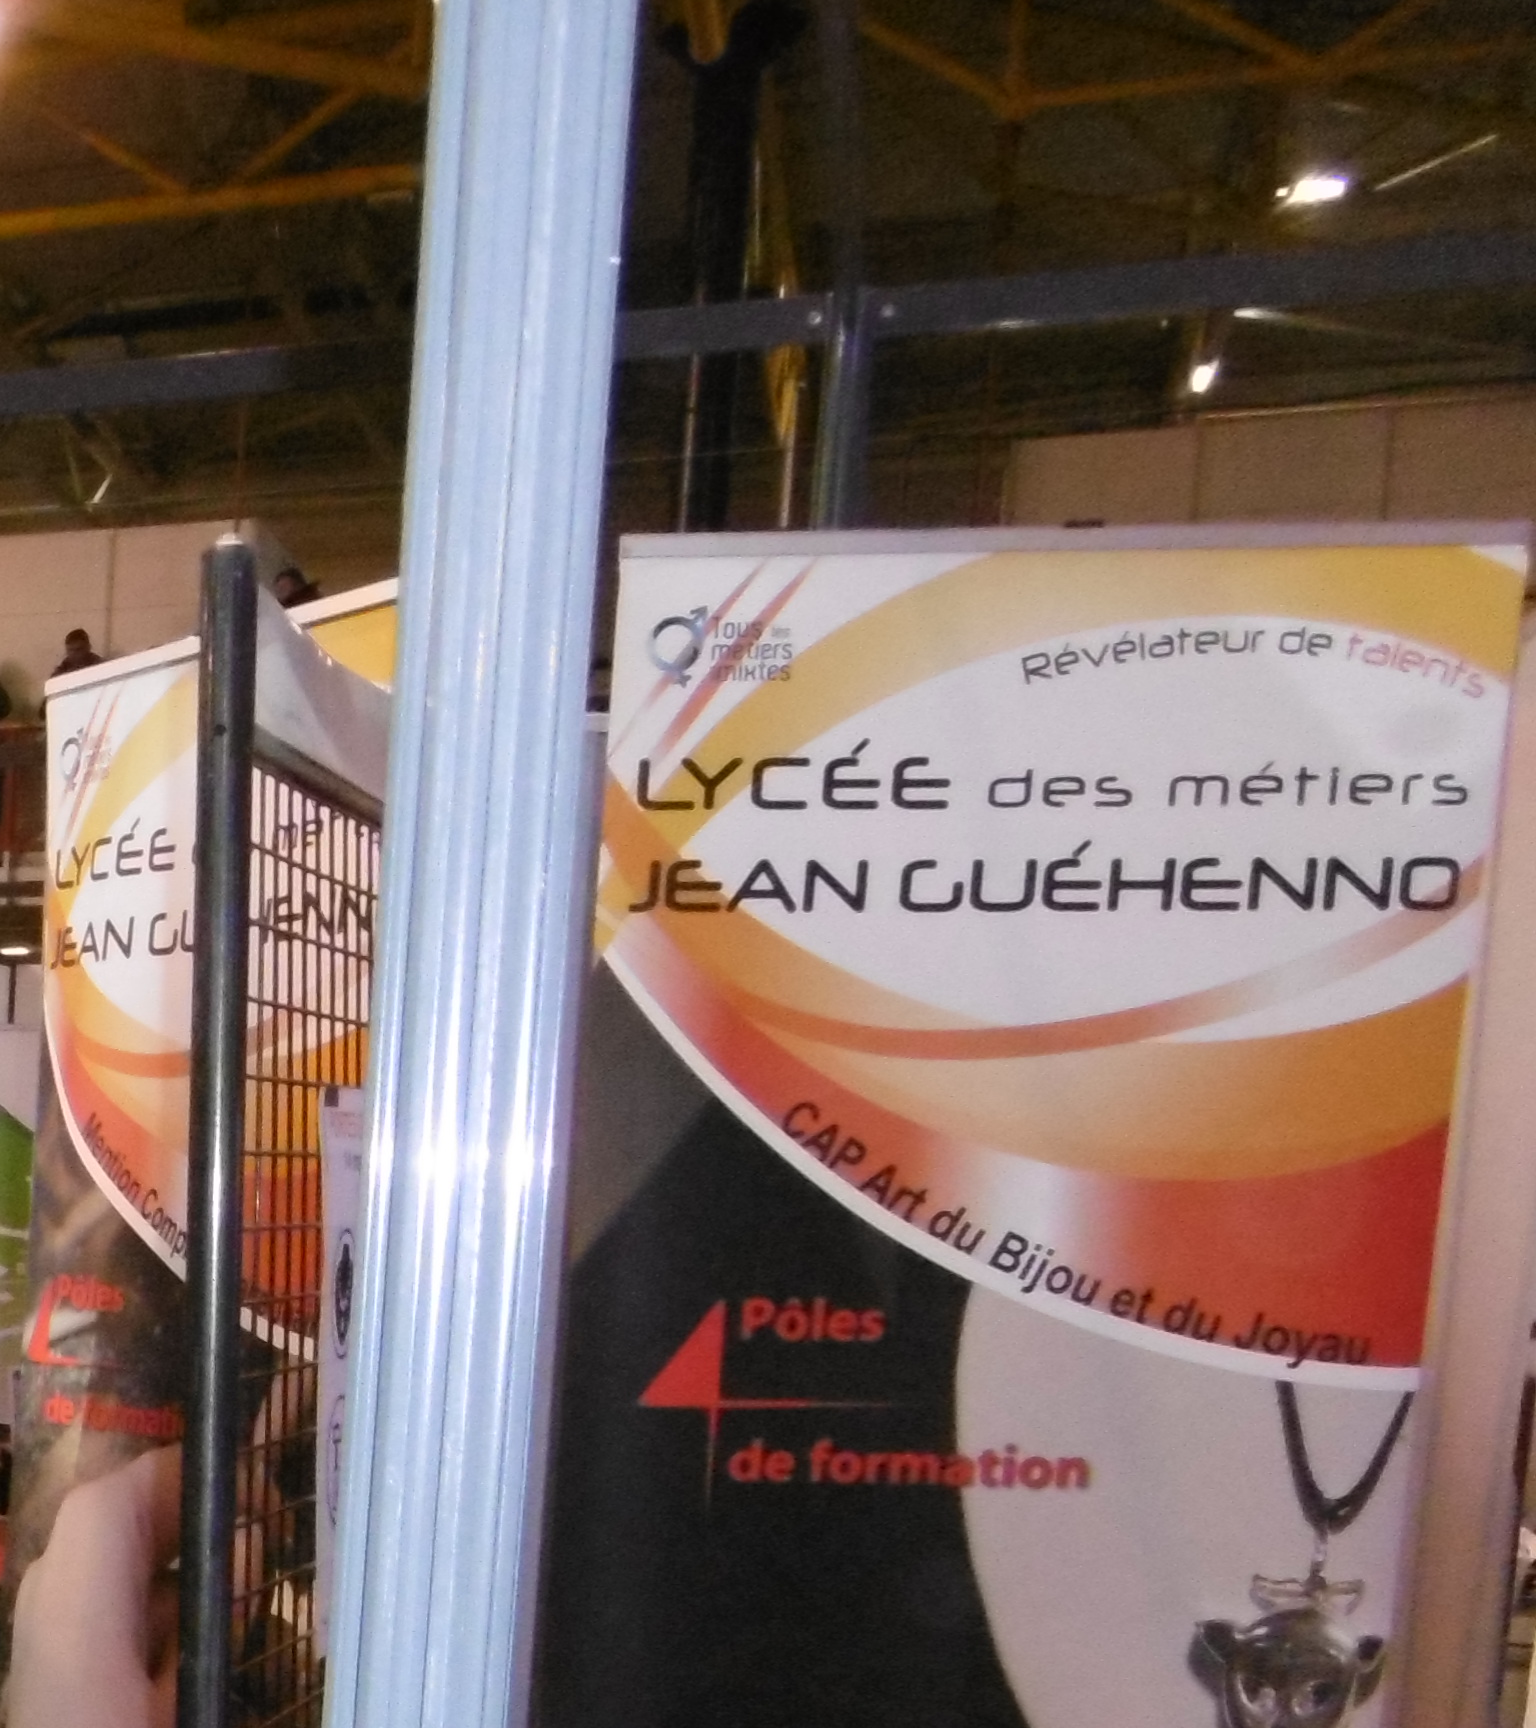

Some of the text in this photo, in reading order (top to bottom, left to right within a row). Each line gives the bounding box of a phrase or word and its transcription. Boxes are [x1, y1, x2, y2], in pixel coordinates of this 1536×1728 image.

[1020, 626, 1486, 700] Révélateur de talents
[636, 737, 1471, 812] LYCÉE des métiers
[54, 816, 177, 891] LYCÉE
[628, 839, 1462, 914] JEAN GUÉHENNO
[49, 915, 137, 970] JEAN
[781, 1101, 1372, 1370] CAP Art du Bijou et du Joyau
[738, 1295, 887, 1345] Pôles
[728, 1437, 1092, 1492] de formation
